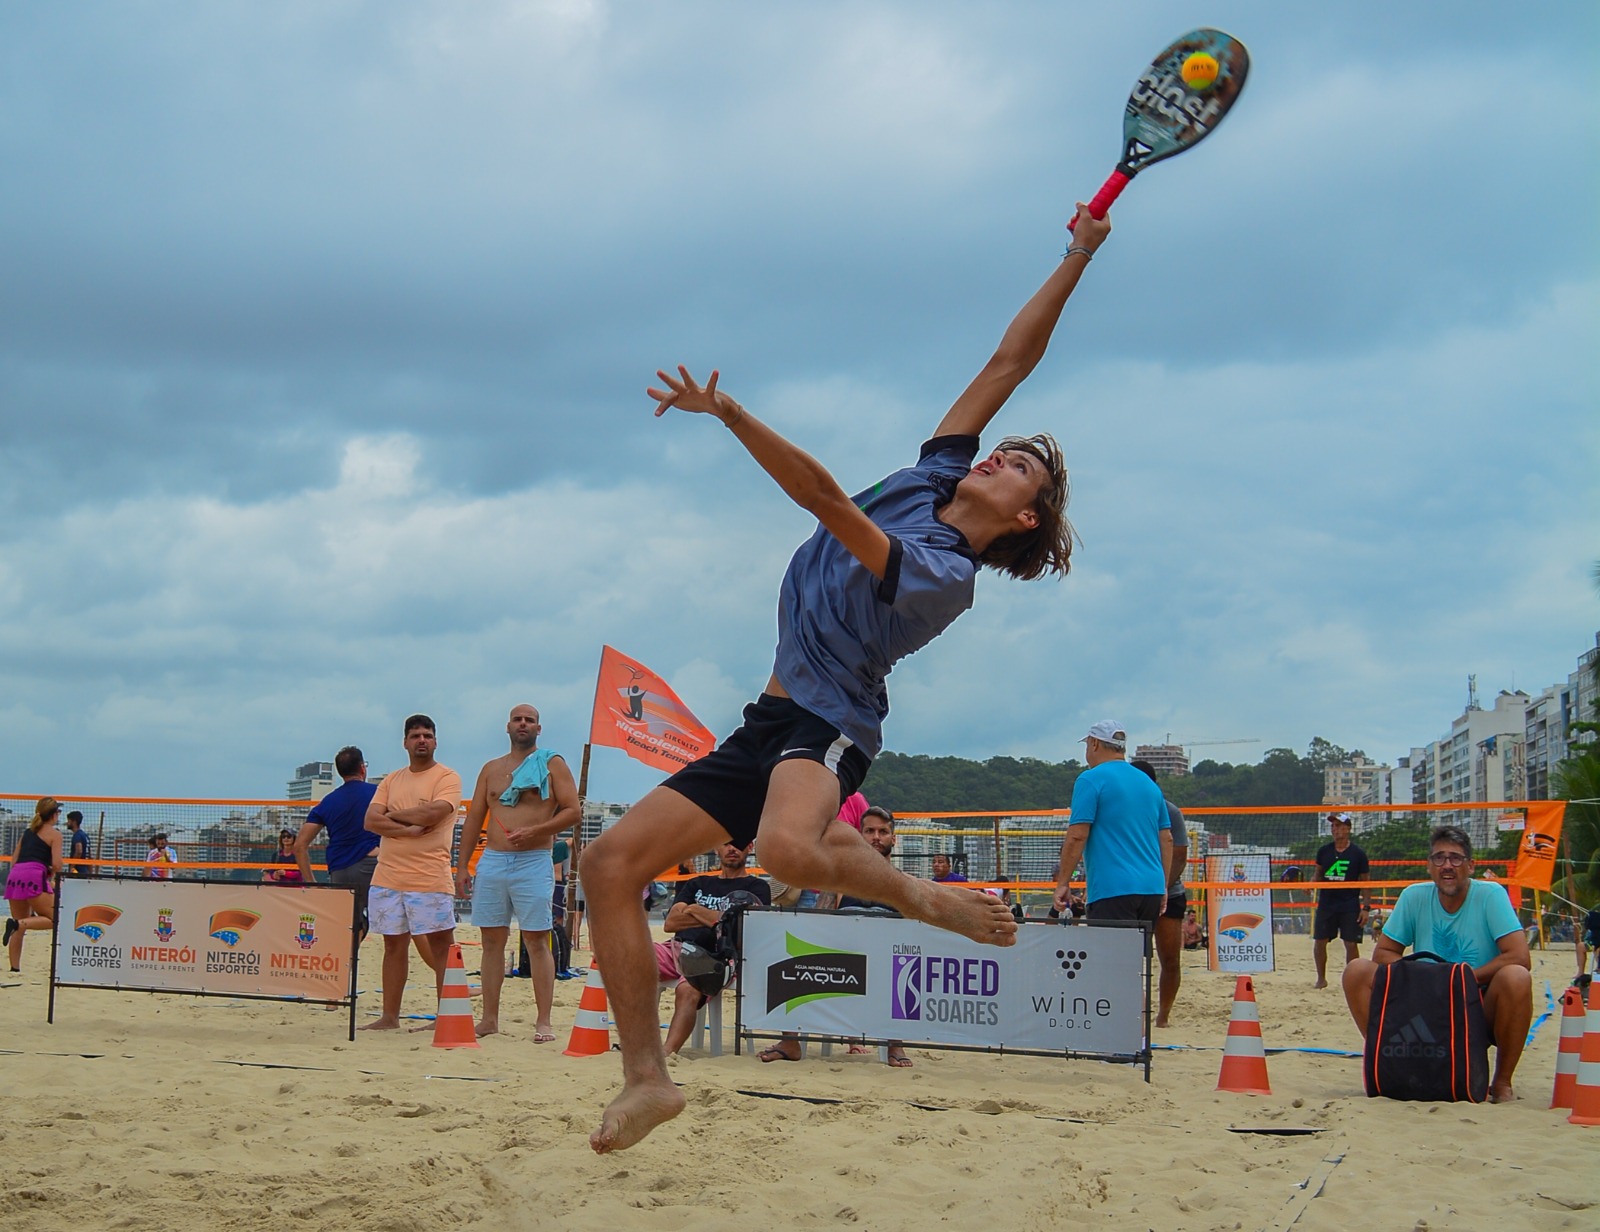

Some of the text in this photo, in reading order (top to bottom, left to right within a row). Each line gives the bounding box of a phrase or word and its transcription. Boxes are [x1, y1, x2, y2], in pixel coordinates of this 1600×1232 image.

[626, 735, 689, 765] Beach Tenni
[664, 733, 699, 752] CIRCUITO
[72, 944, 122, 959] NITERÓI
[131, 945, 196, 963] NITERÓI
[893, 943, 922, 955] CLÍNICA
[1218, 943, 1267, 955] NITERÓI
[71, 958, 121, 969] ESPORTES
[206, 950, 261, 965] NITERÓI
[270, 953, 340, 972] NITERÓI
[1218, 954, 1267, 962] ESPORTES
[131, 963, 158, 971] SEMPRE
[206, 963, 260, 975] ESPORTES
[270, 971, 298, 979] SEMPRE
[310, 973, 339, 981] FRENTE
[782, 970, 859, 985] L'AQUA
[926, 956, 999, 996] FRED
[1031, 991, 1111, 1017] wine
[926, 998, 999, 1026] SOARES
[1381, 1041, 1446, 1058] adidas
